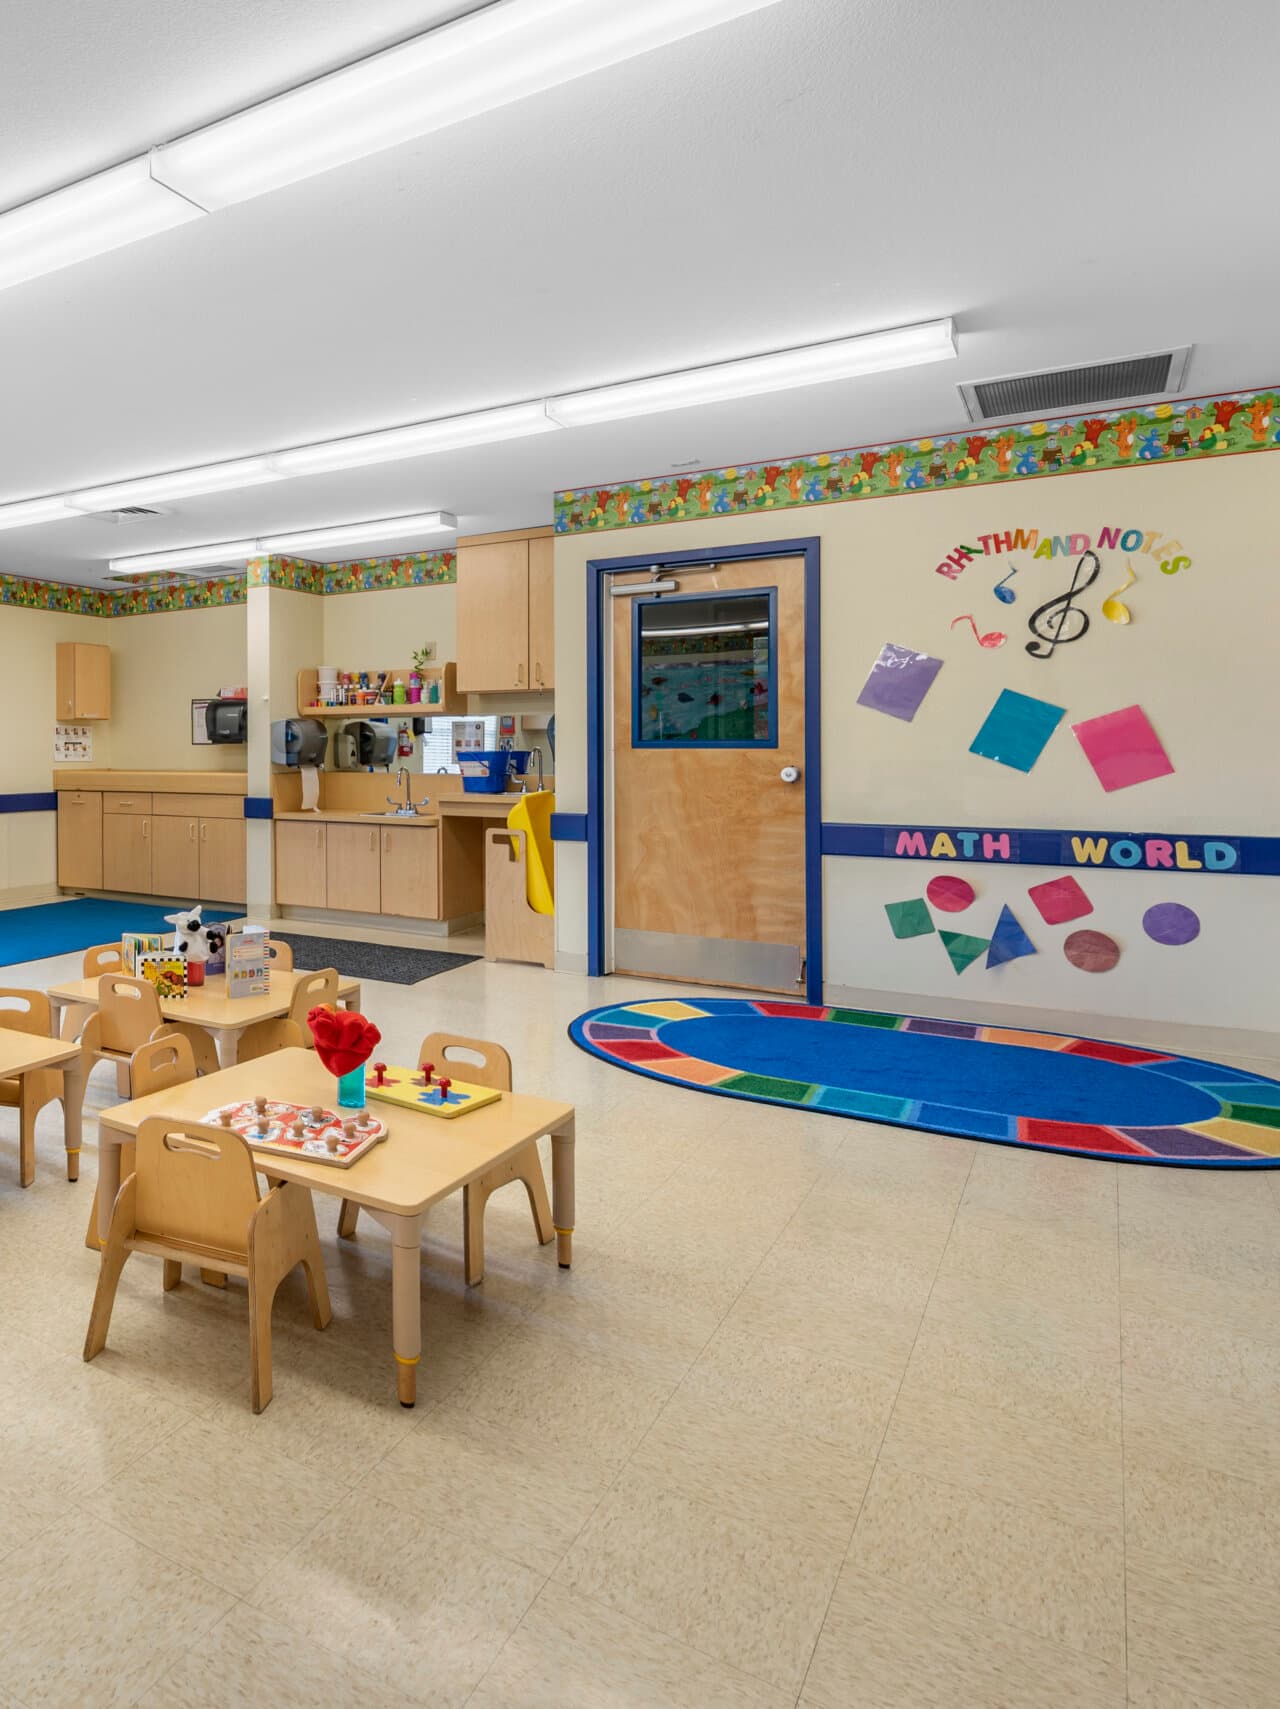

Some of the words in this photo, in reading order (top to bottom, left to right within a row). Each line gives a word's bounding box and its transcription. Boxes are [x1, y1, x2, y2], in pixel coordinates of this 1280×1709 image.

[936, 528, 1039, 581] RHYTHM
[1033, 533, 1090, 560] AND
[1097, 527, 1191, 575] NOTES
[895, 831, 1010, 859] MATH
[1071, 836, 1237, 870] WORLD
